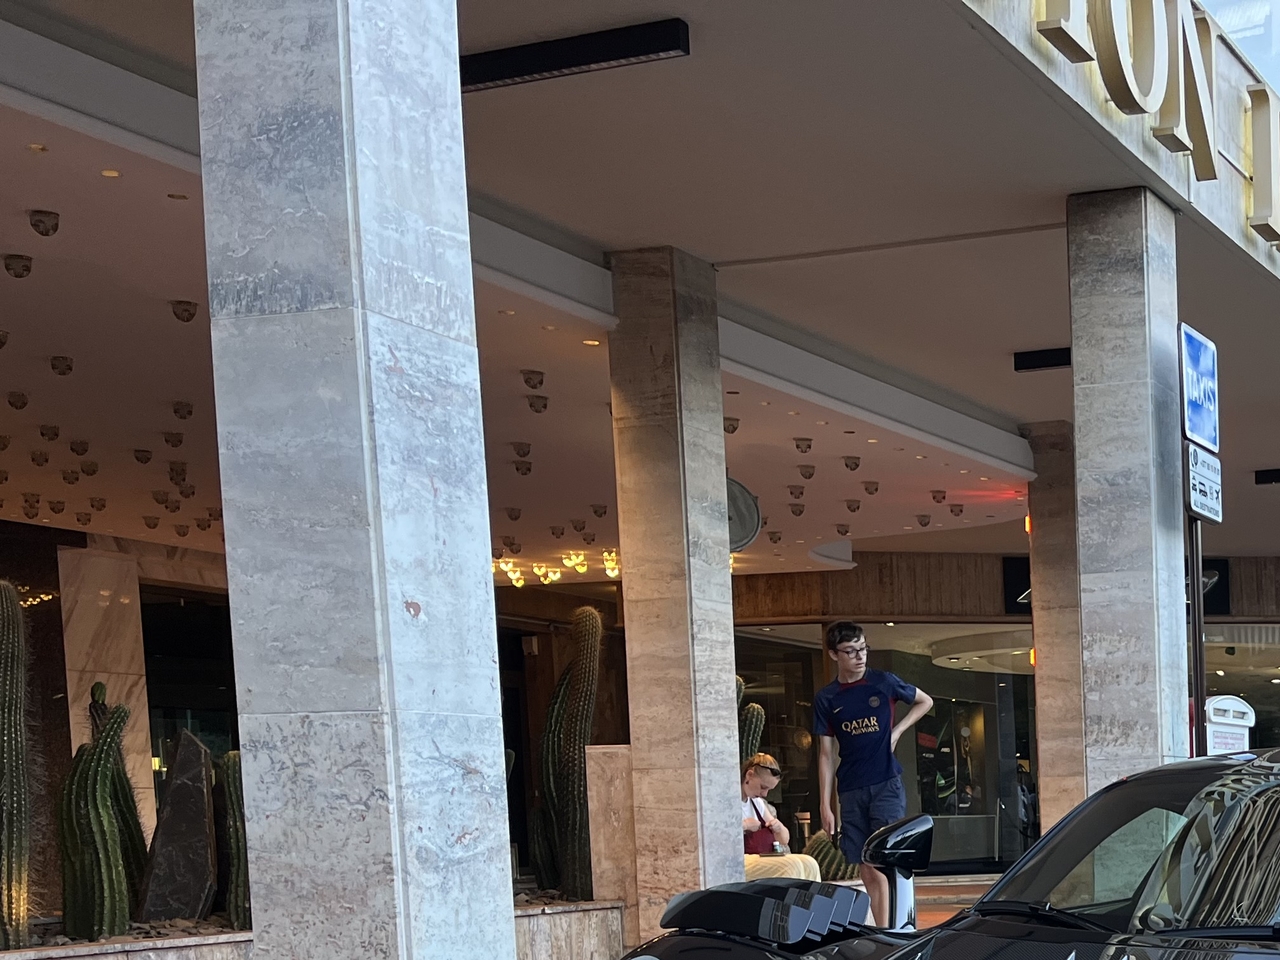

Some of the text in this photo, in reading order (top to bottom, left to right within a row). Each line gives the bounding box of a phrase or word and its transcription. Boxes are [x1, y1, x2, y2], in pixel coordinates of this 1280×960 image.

[1186, 367, 1215, 412] TAXIS
[841, 716, 879, 732] QATAR
[852, 725, 880, 736] AIRWAYS
